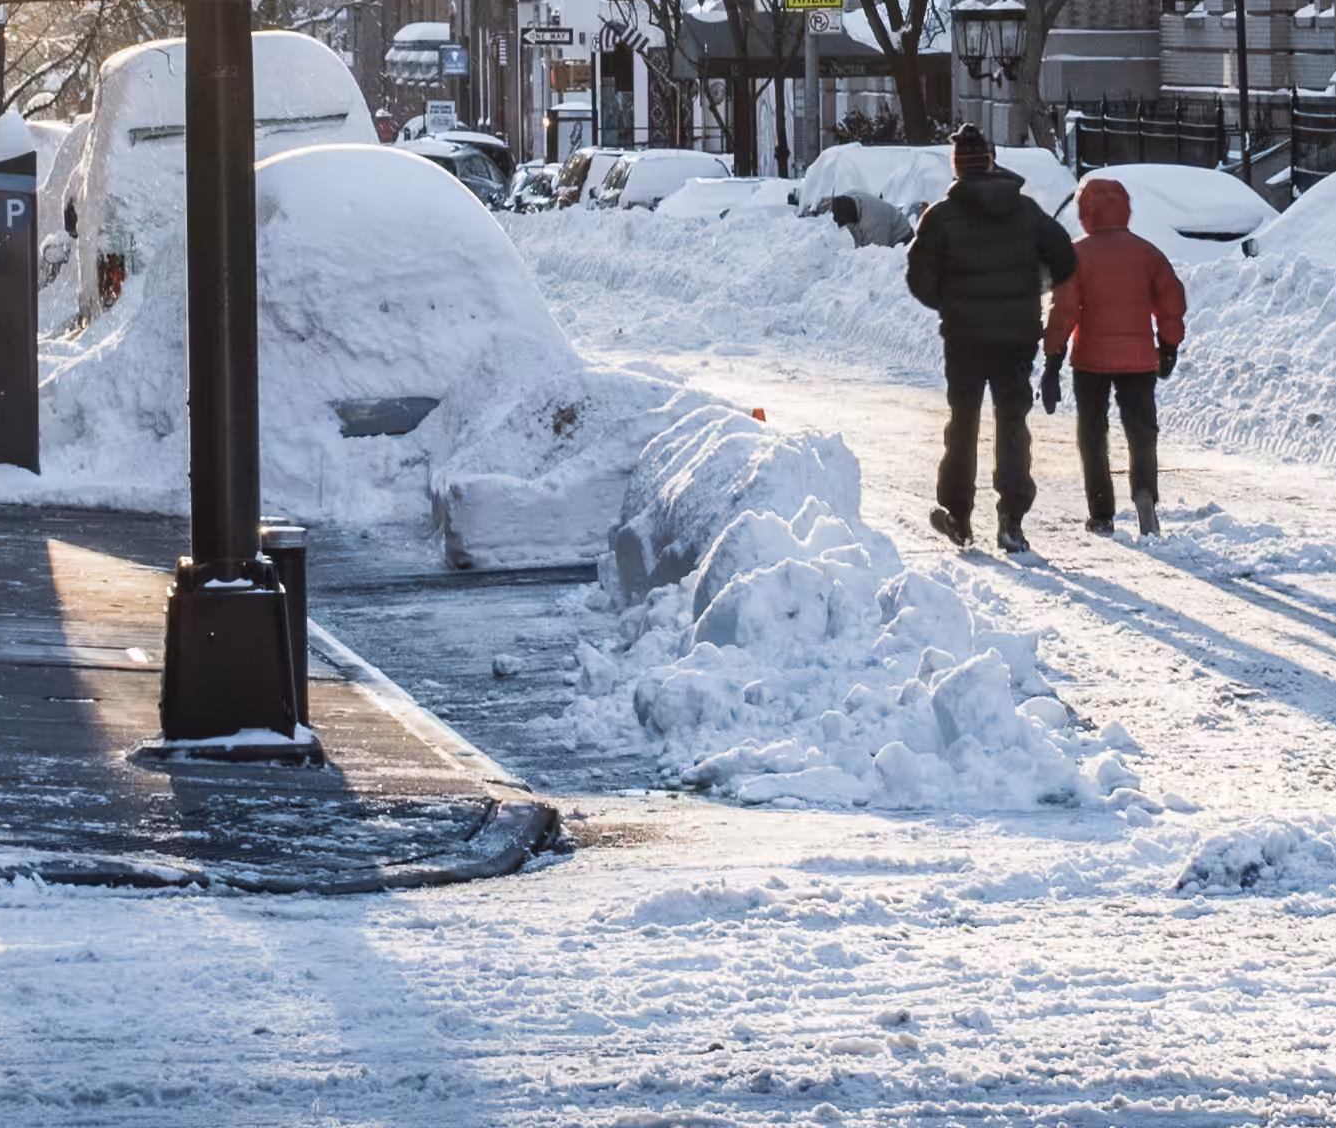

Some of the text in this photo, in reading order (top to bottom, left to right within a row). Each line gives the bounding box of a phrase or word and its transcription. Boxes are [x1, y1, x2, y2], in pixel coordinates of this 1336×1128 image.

[529, 32, 566, 40] ONE WAY
[7, 198, 26, 228] P
